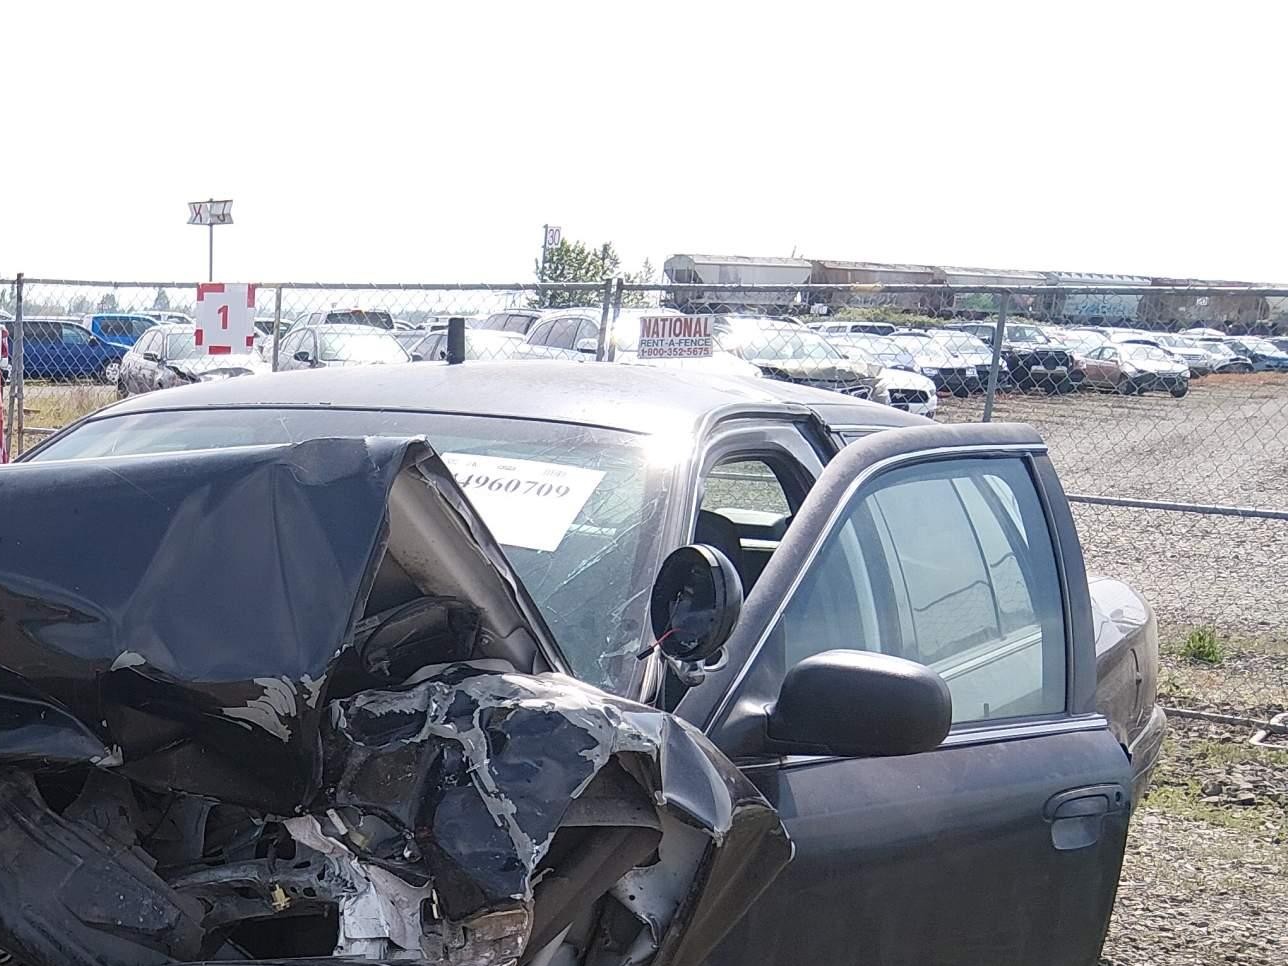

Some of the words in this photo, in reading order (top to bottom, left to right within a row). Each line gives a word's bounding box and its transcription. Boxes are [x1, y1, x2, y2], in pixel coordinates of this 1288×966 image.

[548, 229, 560, 245] 30
[217, 305, 228, 329] 1
[641, 318, 711, 338] NATIONAL
[640, 339, 711, 347] RENT-A-FENCE
